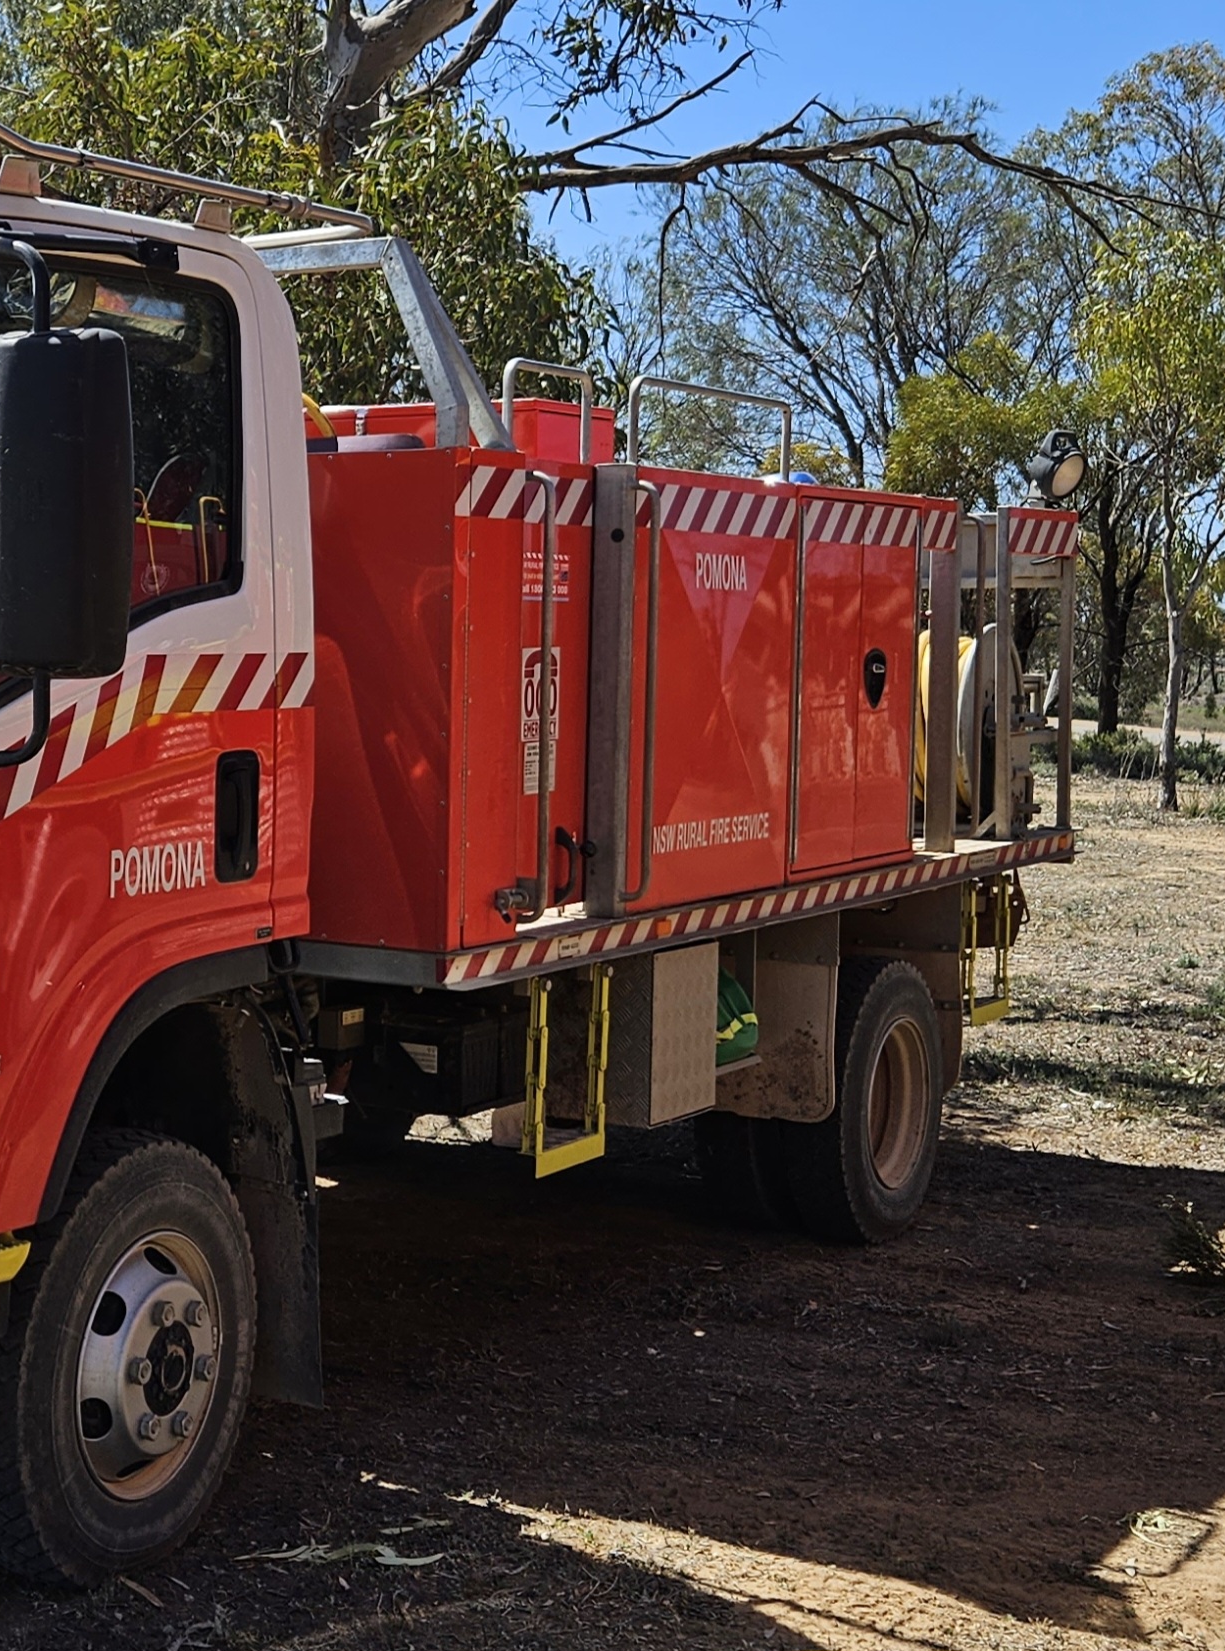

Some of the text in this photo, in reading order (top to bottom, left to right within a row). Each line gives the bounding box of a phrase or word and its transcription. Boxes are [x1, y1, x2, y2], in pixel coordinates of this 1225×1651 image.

[696, 552, 747, 591] POMONA
[523, 721, 557, 738] EMERCY
[652, 811, 770, 855] NSW RURAL FIRE SERVICE
[110, 840, 206, 899] POMONA
